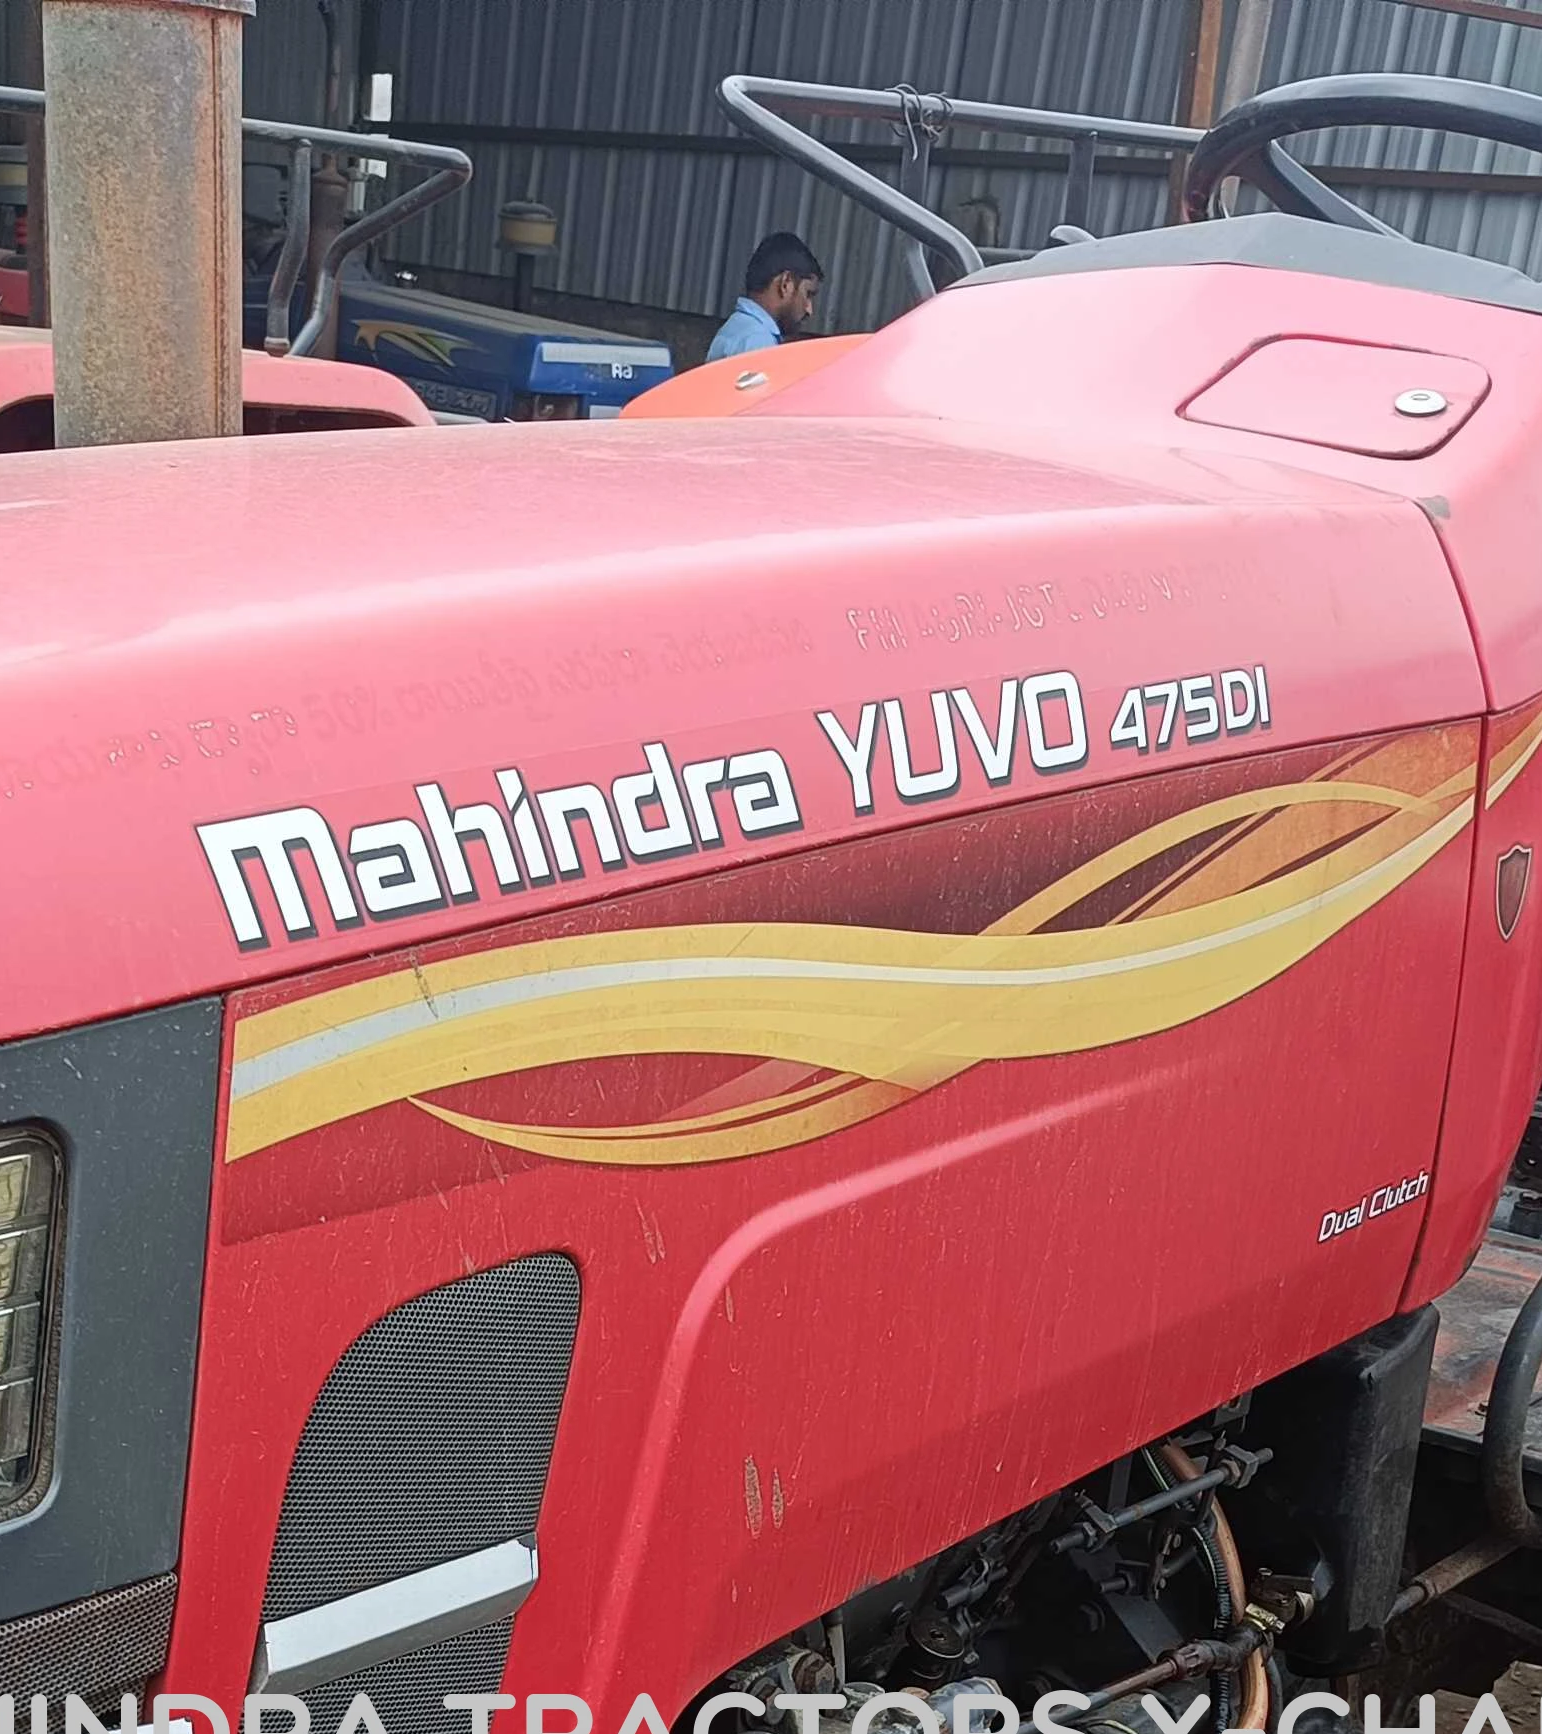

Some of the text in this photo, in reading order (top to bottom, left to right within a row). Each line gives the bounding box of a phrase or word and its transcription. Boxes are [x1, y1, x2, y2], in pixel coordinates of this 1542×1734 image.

[814, 669, 1088, 816] YUVO
[1110, 664, 1271, 756] 475DI
[1317, 1169, 1429, 1242] Dual Clutch
